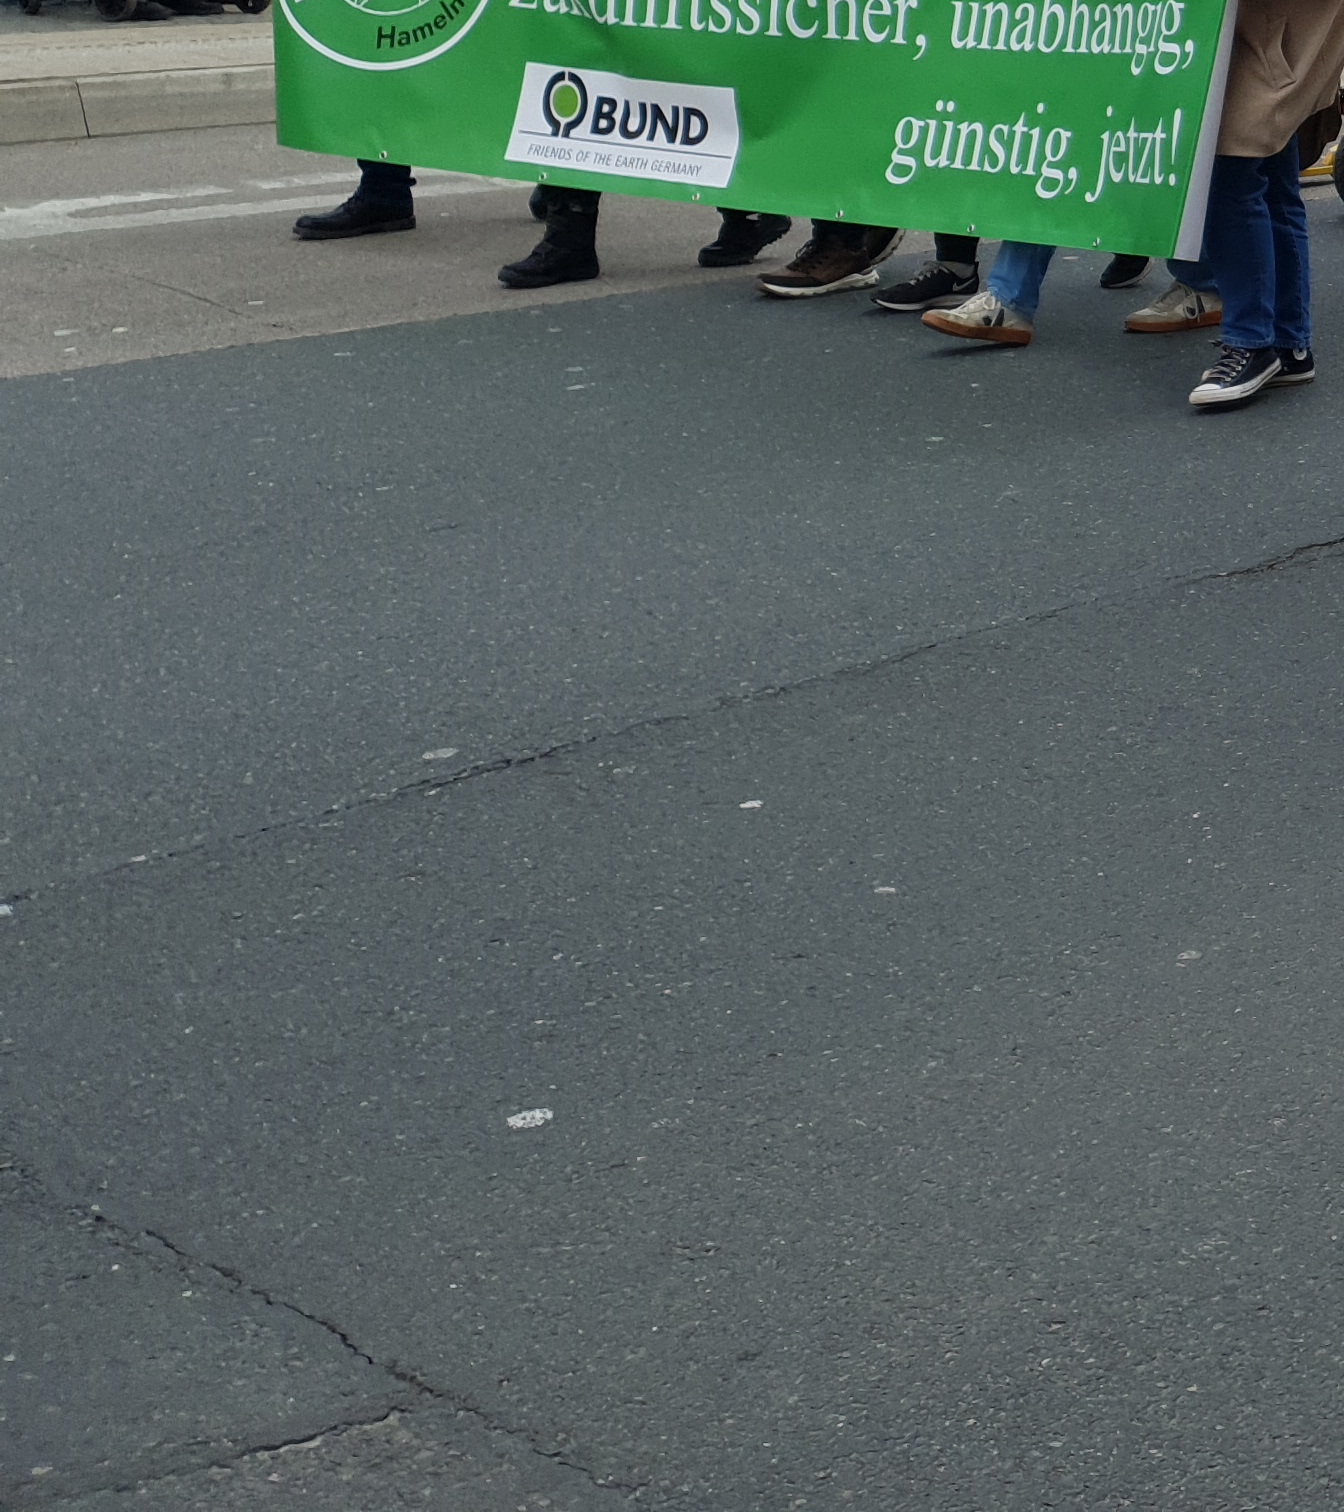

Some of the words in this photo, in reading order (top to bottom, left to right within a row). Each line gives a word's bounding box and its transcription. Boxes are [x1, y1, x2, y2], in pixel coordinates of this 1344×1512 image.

[589, 95, 709, 147] BUND
[526, 143, 573, 161] FRIENDS
[575, 150, 591, 163] OF
[592, 152, 612, 166] THE
[614, 154, 648, 171] EARTH
[650, 160, 703, 177] GERMANY
[884, 99, 1078, 199] günstig,
[1084, 105, 1182, 203] jetzt!
